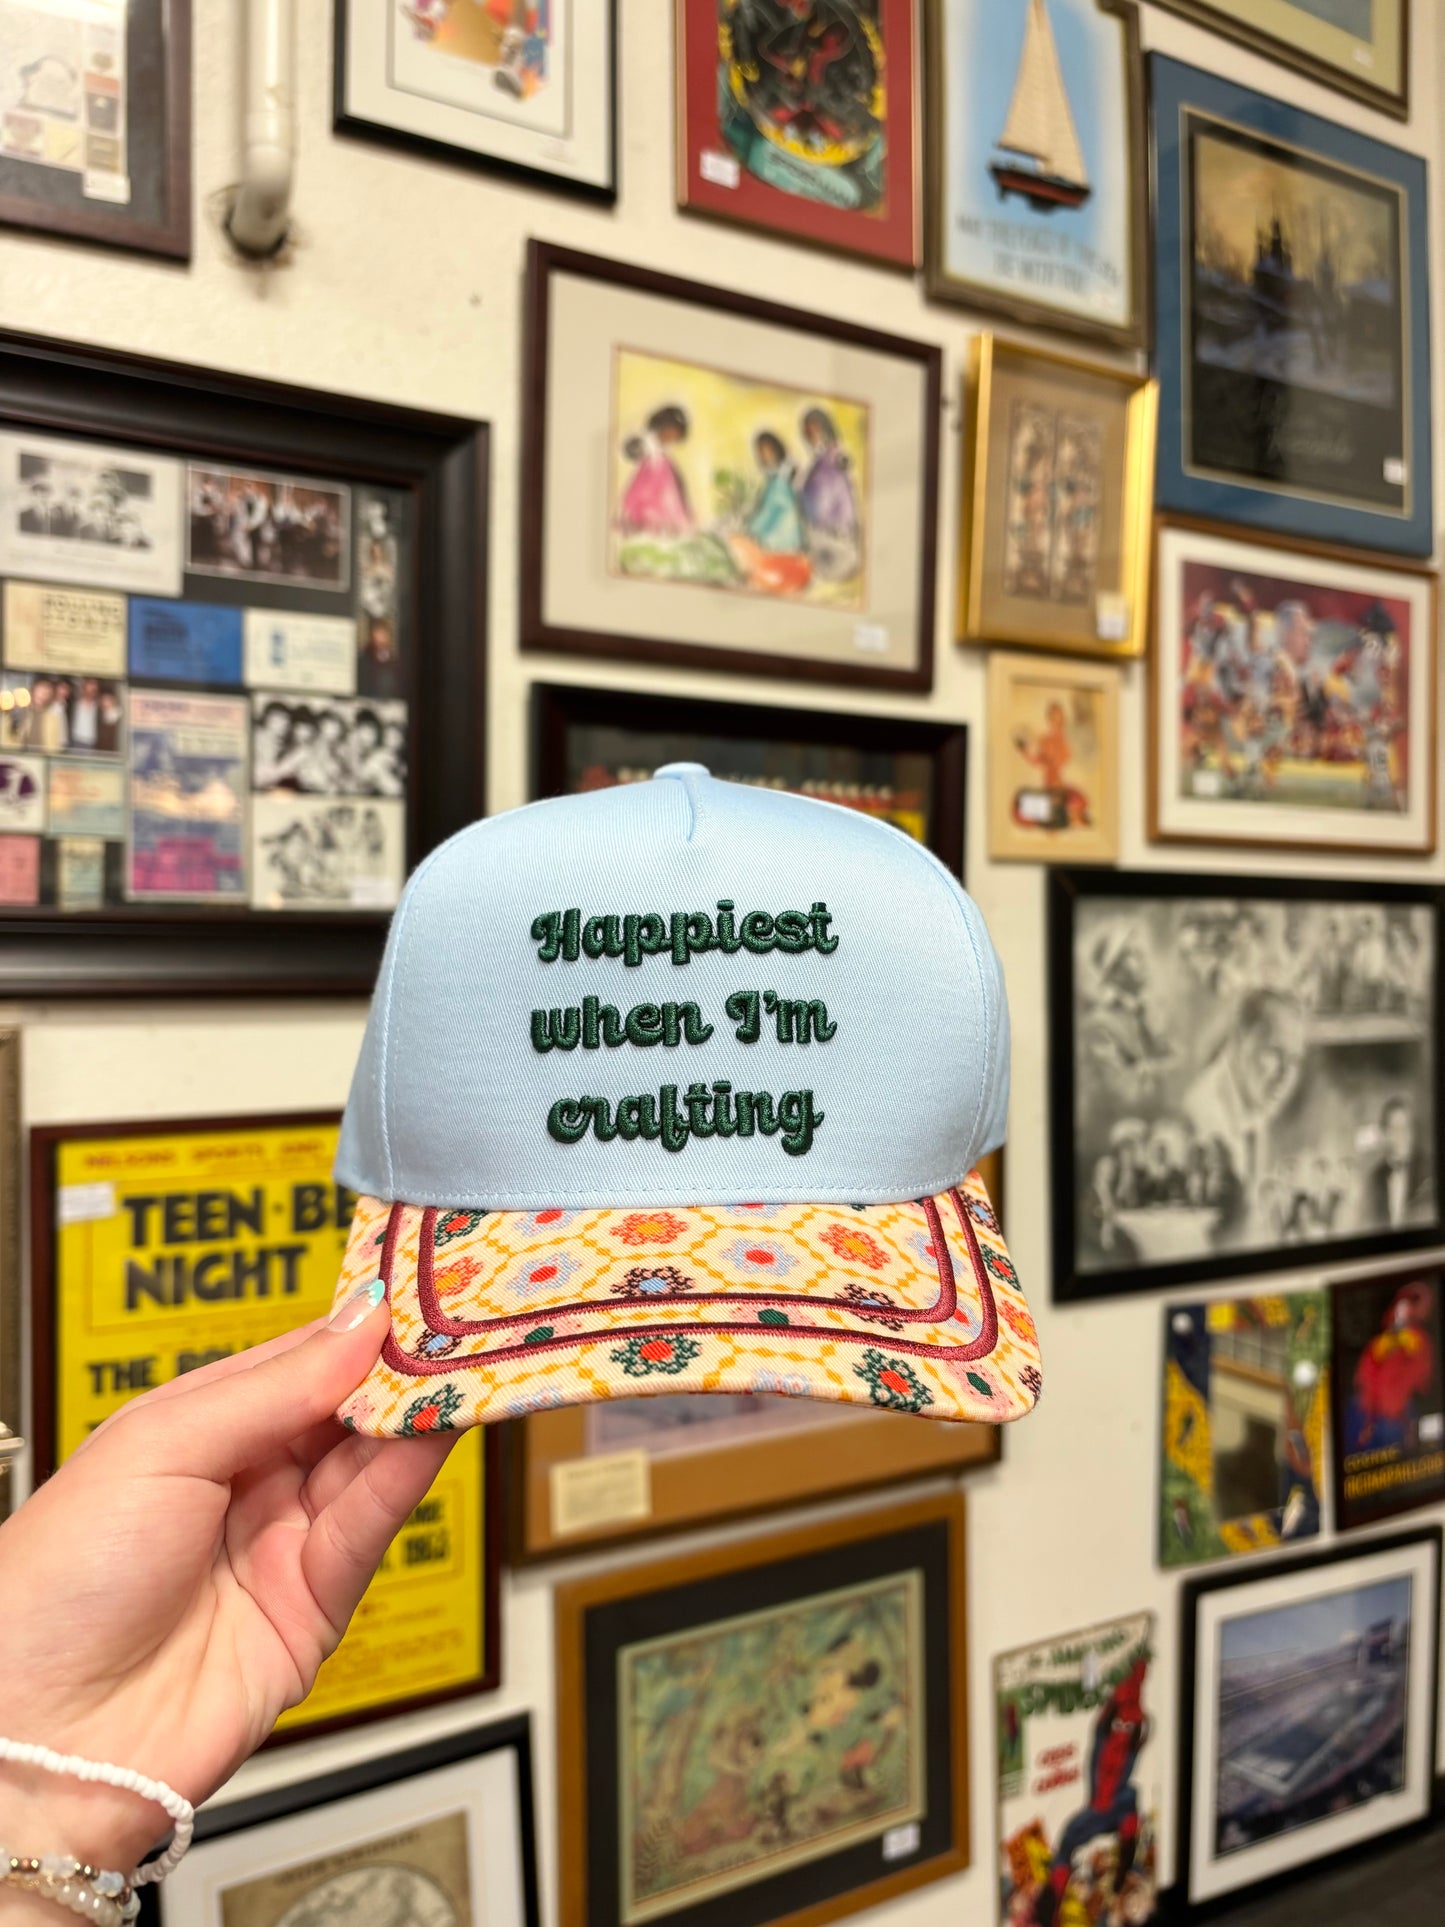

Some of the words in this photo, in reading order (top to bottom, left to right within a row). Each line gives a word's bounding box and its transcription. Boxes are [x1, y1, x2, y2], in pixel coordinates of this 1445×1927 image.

[531, 899, 839, 967] Happiest
[531, 995, 714, 1053] when
[725, 989, 838, 1044] I'm
[547, 1080, 825, 1156] crafting
[124, 1244, 308, 1312] NIGHT
[88, 1355, 157, 1396] THE
